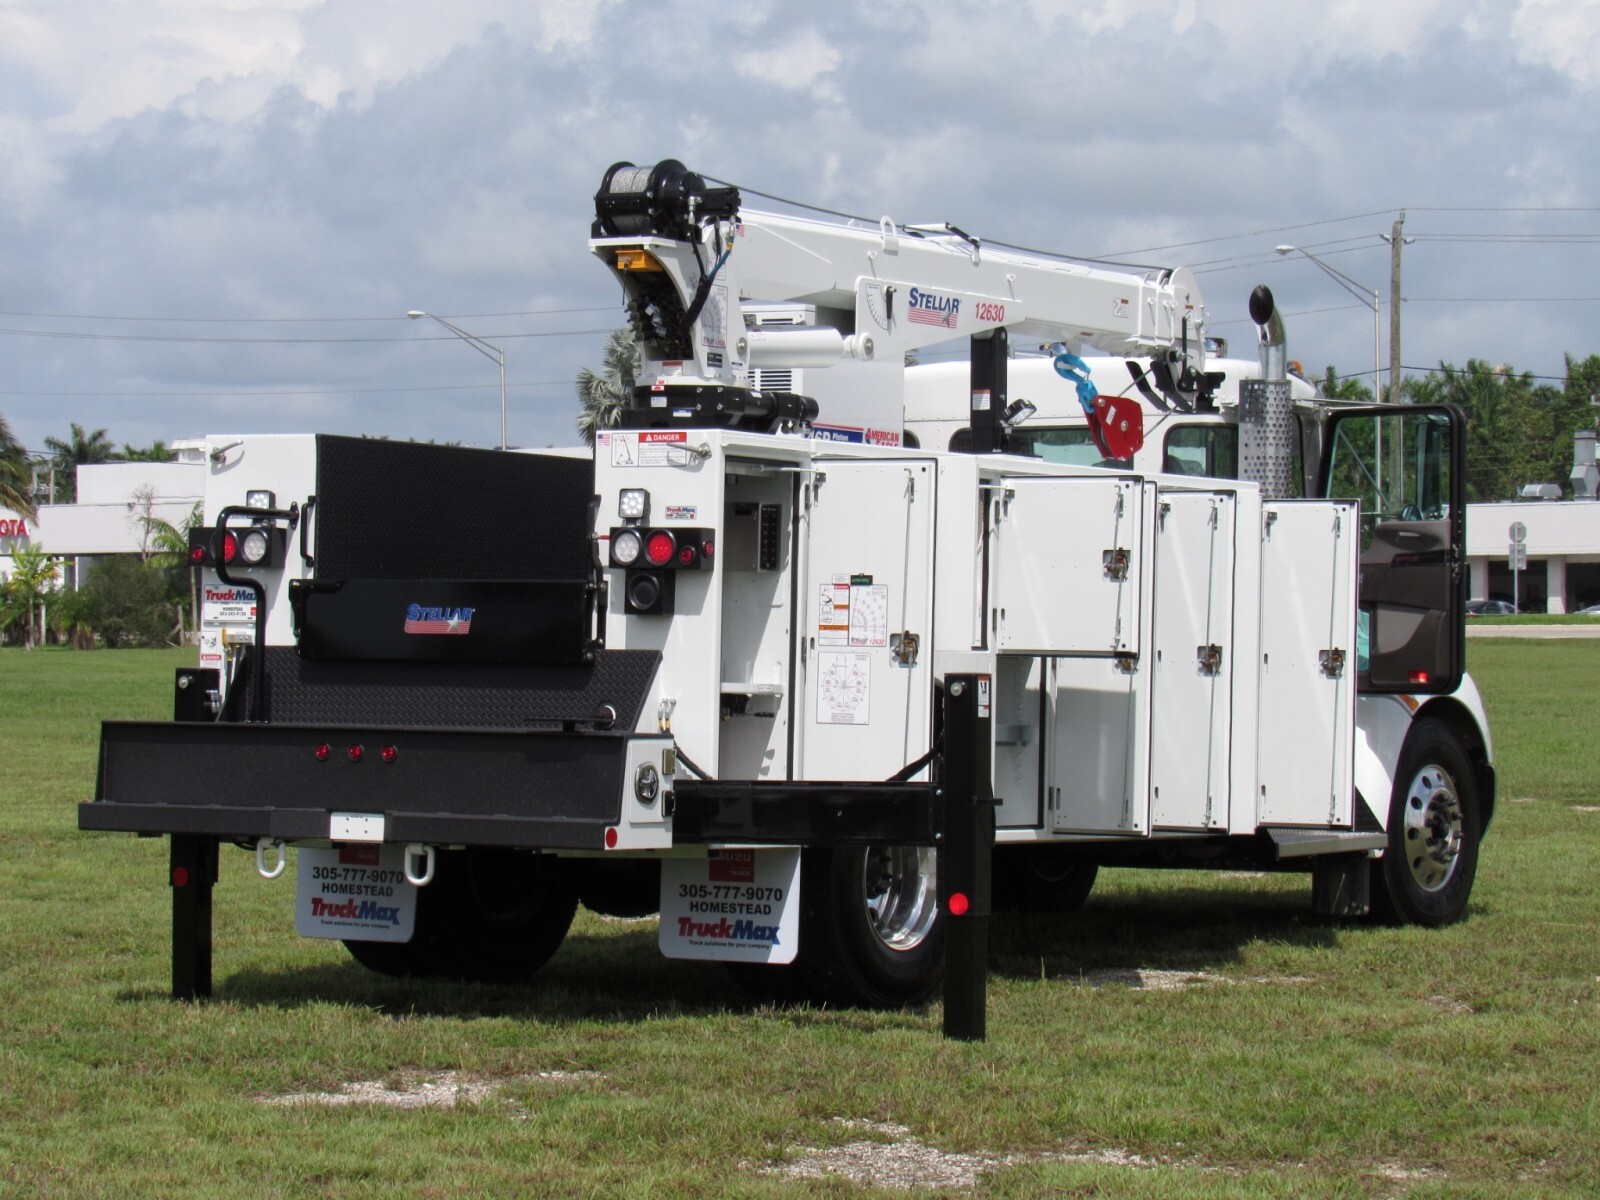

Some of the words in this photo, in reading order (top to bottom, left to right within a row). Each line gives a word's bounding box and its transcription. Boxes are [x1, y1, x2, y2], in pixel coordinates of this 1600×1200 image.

[908, 286, 961, 314] STELLAR
[974, 302, 1005, 323] 12630
[653, 433, 681, 441] DANGER
[832, 432, 849, 441] Piston
[865, 427, 899, 442] AMERICAN
[0, 519, 28, 537] OTA
[405, 603, 474, 622] STELLAR
[719, 851, 752, 862] SUZU
[312, 866, 405, 884] 305-777-9070
[321, 883, 394, 897] HOMESTEAD
[678, 884, 783, 901] 305-777-9070
[311, 897, 401, 925] TruckMax
[689, 901, 772, 915] HOMESTEAD
[677, 916, 781, 945] TruckMax
[748, 942, 770, 950] company
